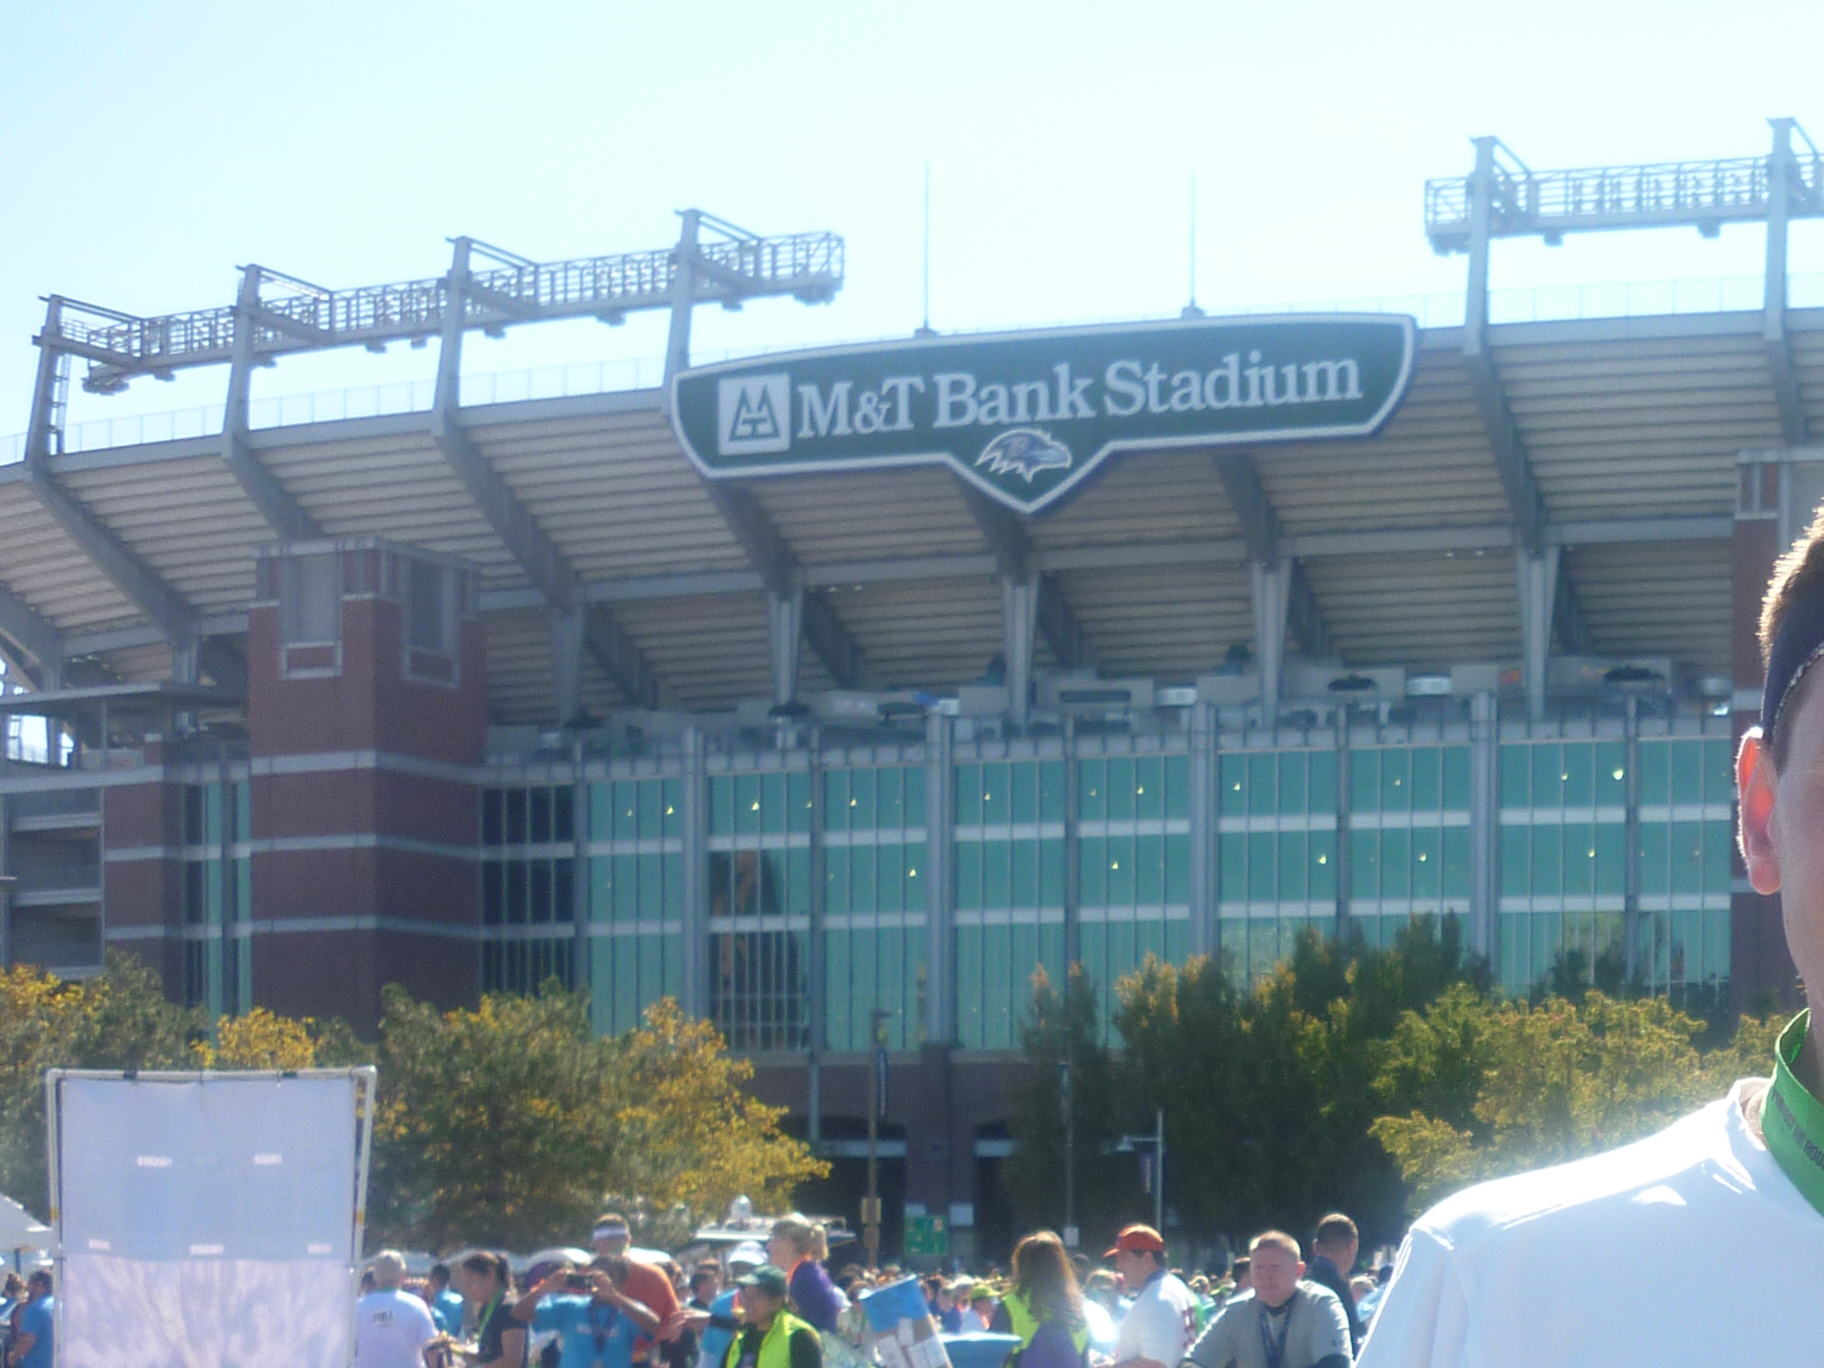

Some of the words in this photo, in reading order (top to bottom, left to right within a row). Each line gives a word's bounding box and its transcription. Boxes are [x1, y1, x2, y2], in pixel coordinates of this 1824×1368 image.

[797, 373, 926, 438] M&T
[932, 363, 1097, 429] Bank
[1103, 349, 1364, 417] Stadium
